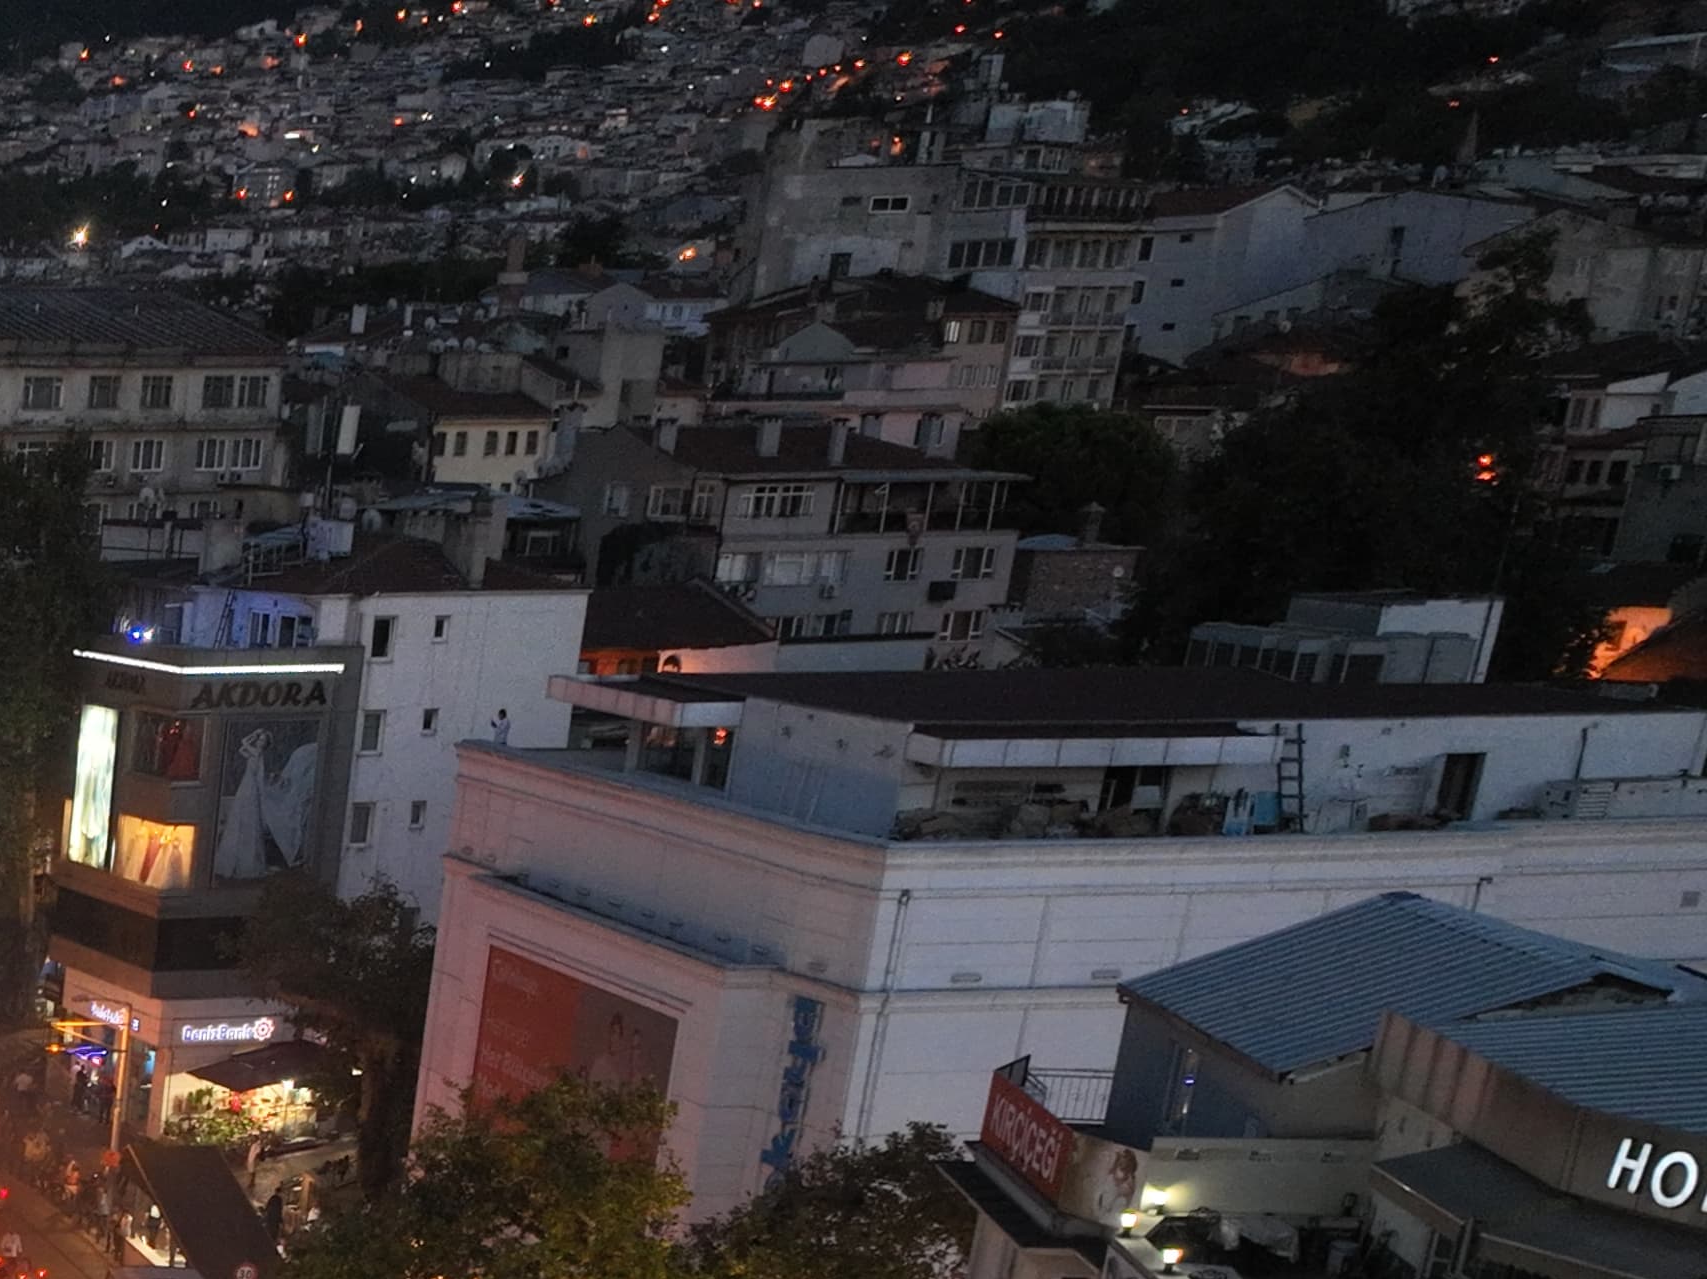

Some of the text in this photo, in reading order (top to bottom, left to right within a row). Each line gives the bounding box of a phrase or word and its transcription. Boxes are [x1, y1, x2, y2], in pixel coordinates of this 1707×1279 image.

[190, 680, 327, 708] AKDORA
[182, 1024, 255, 1042] DenizBank
[1607, 1138, 1707, 1213] HO
